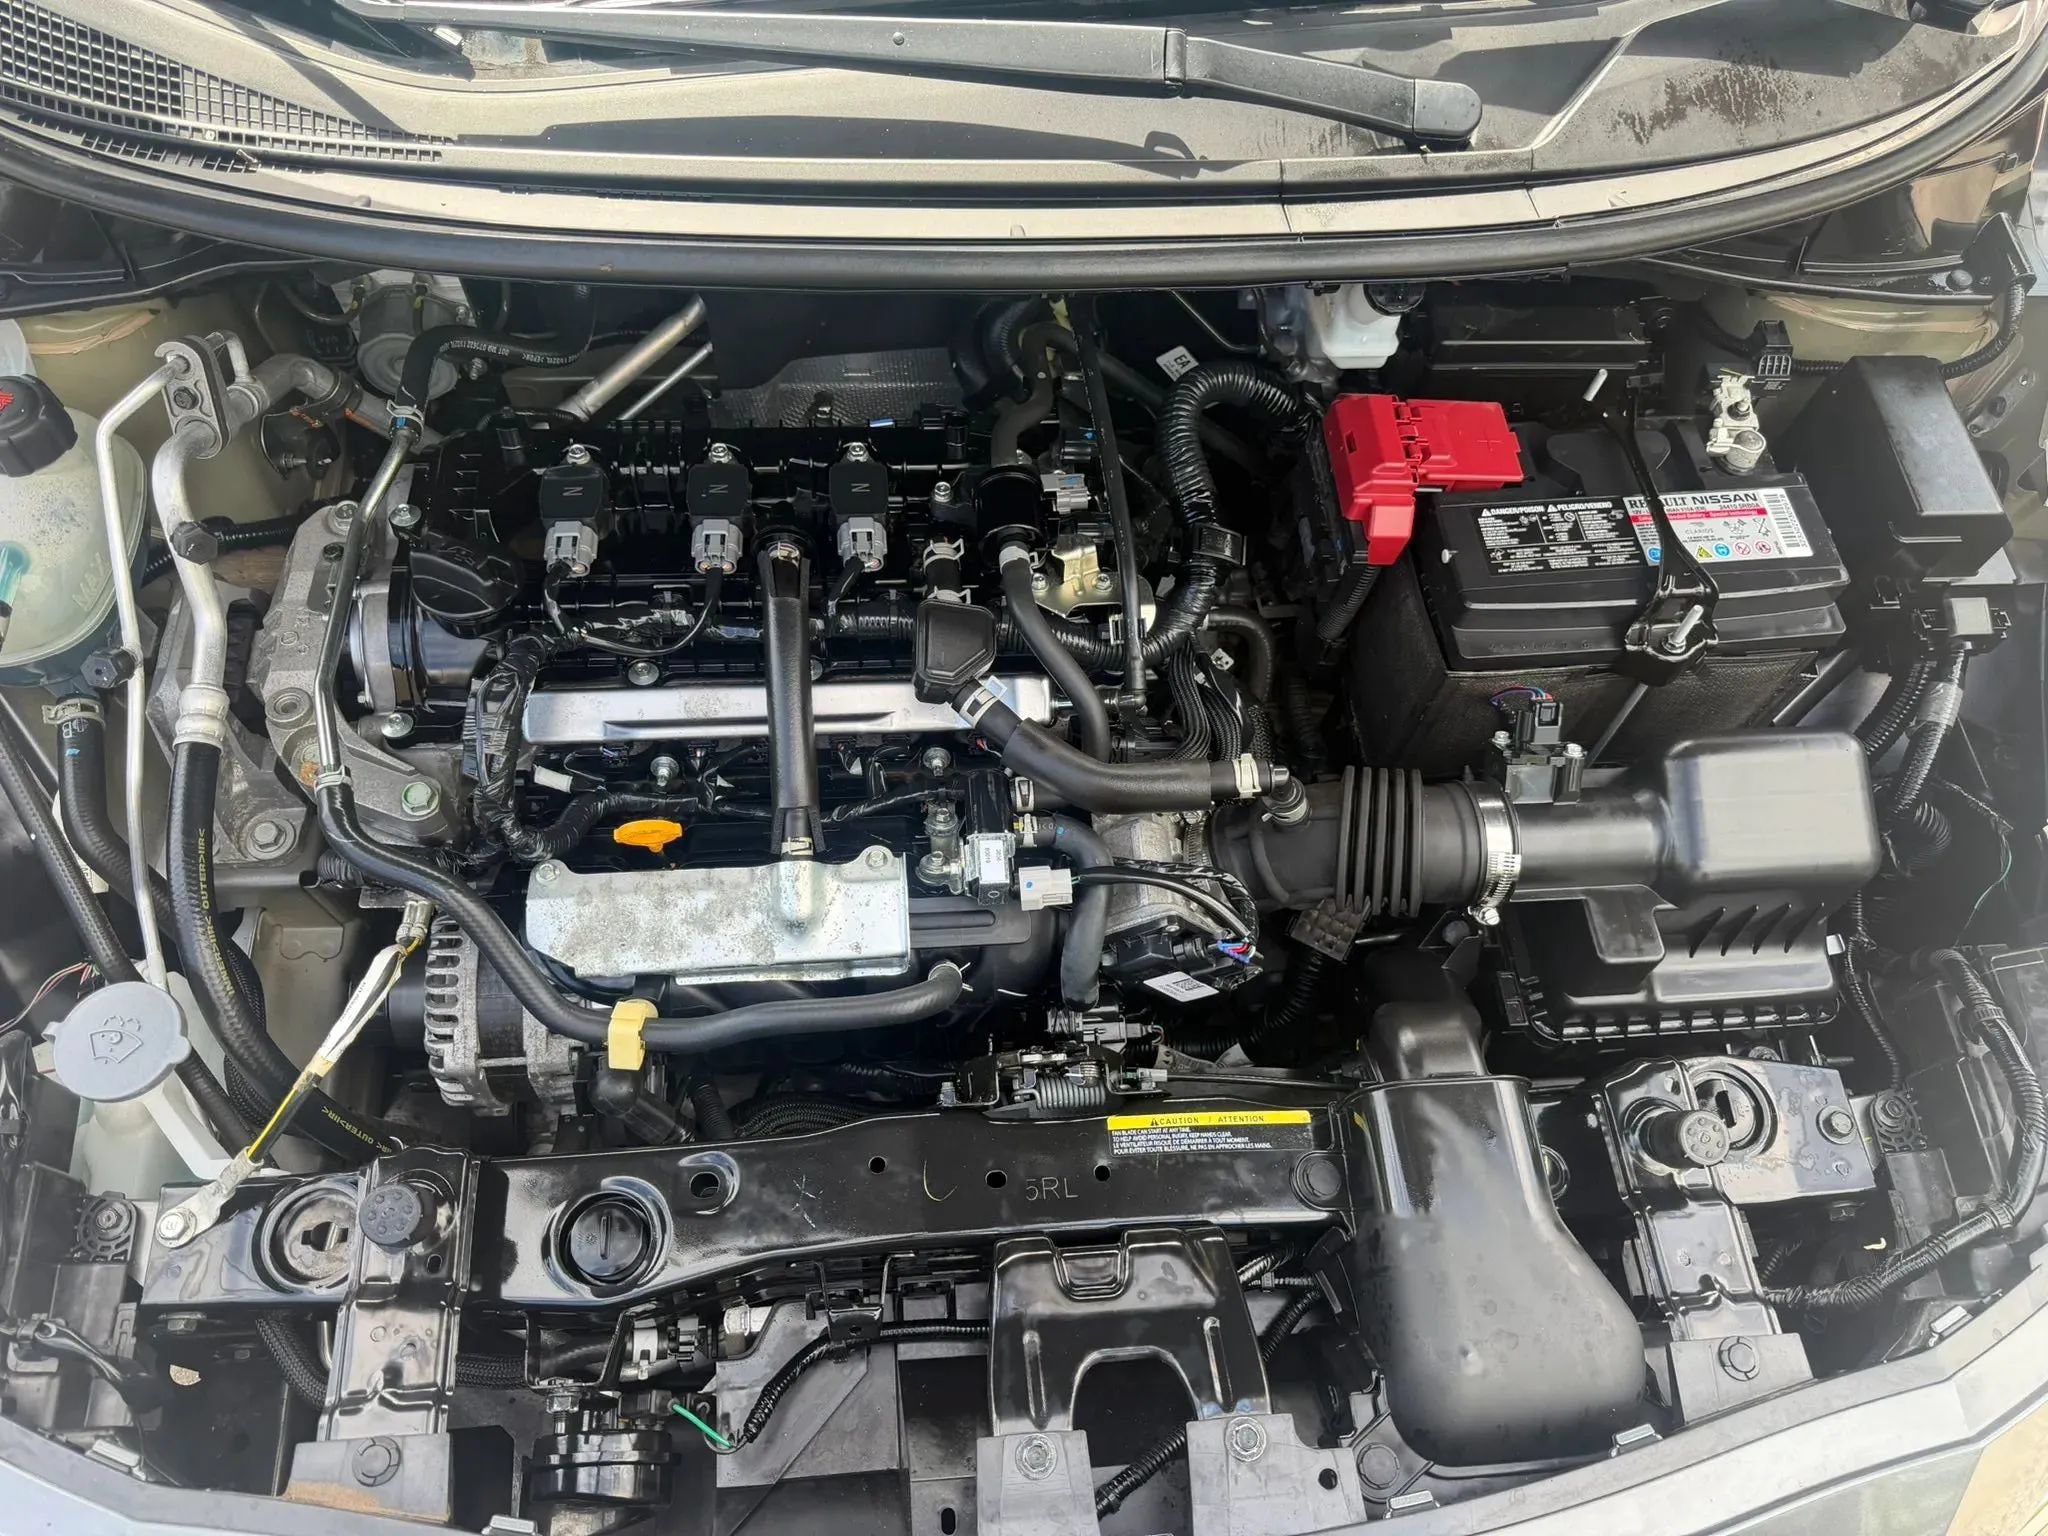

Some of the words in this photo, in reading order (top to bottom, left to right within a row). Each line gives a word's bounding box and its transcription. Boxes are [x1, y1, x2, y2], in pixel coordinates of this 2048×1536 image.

[1174, 354, 1191, 368] EA
[1628, 495, 1688, 509] REULT
[1692, 492, 1758, 505] NISSAN
[1160, 1117, 1199, 1125] CAUTION
